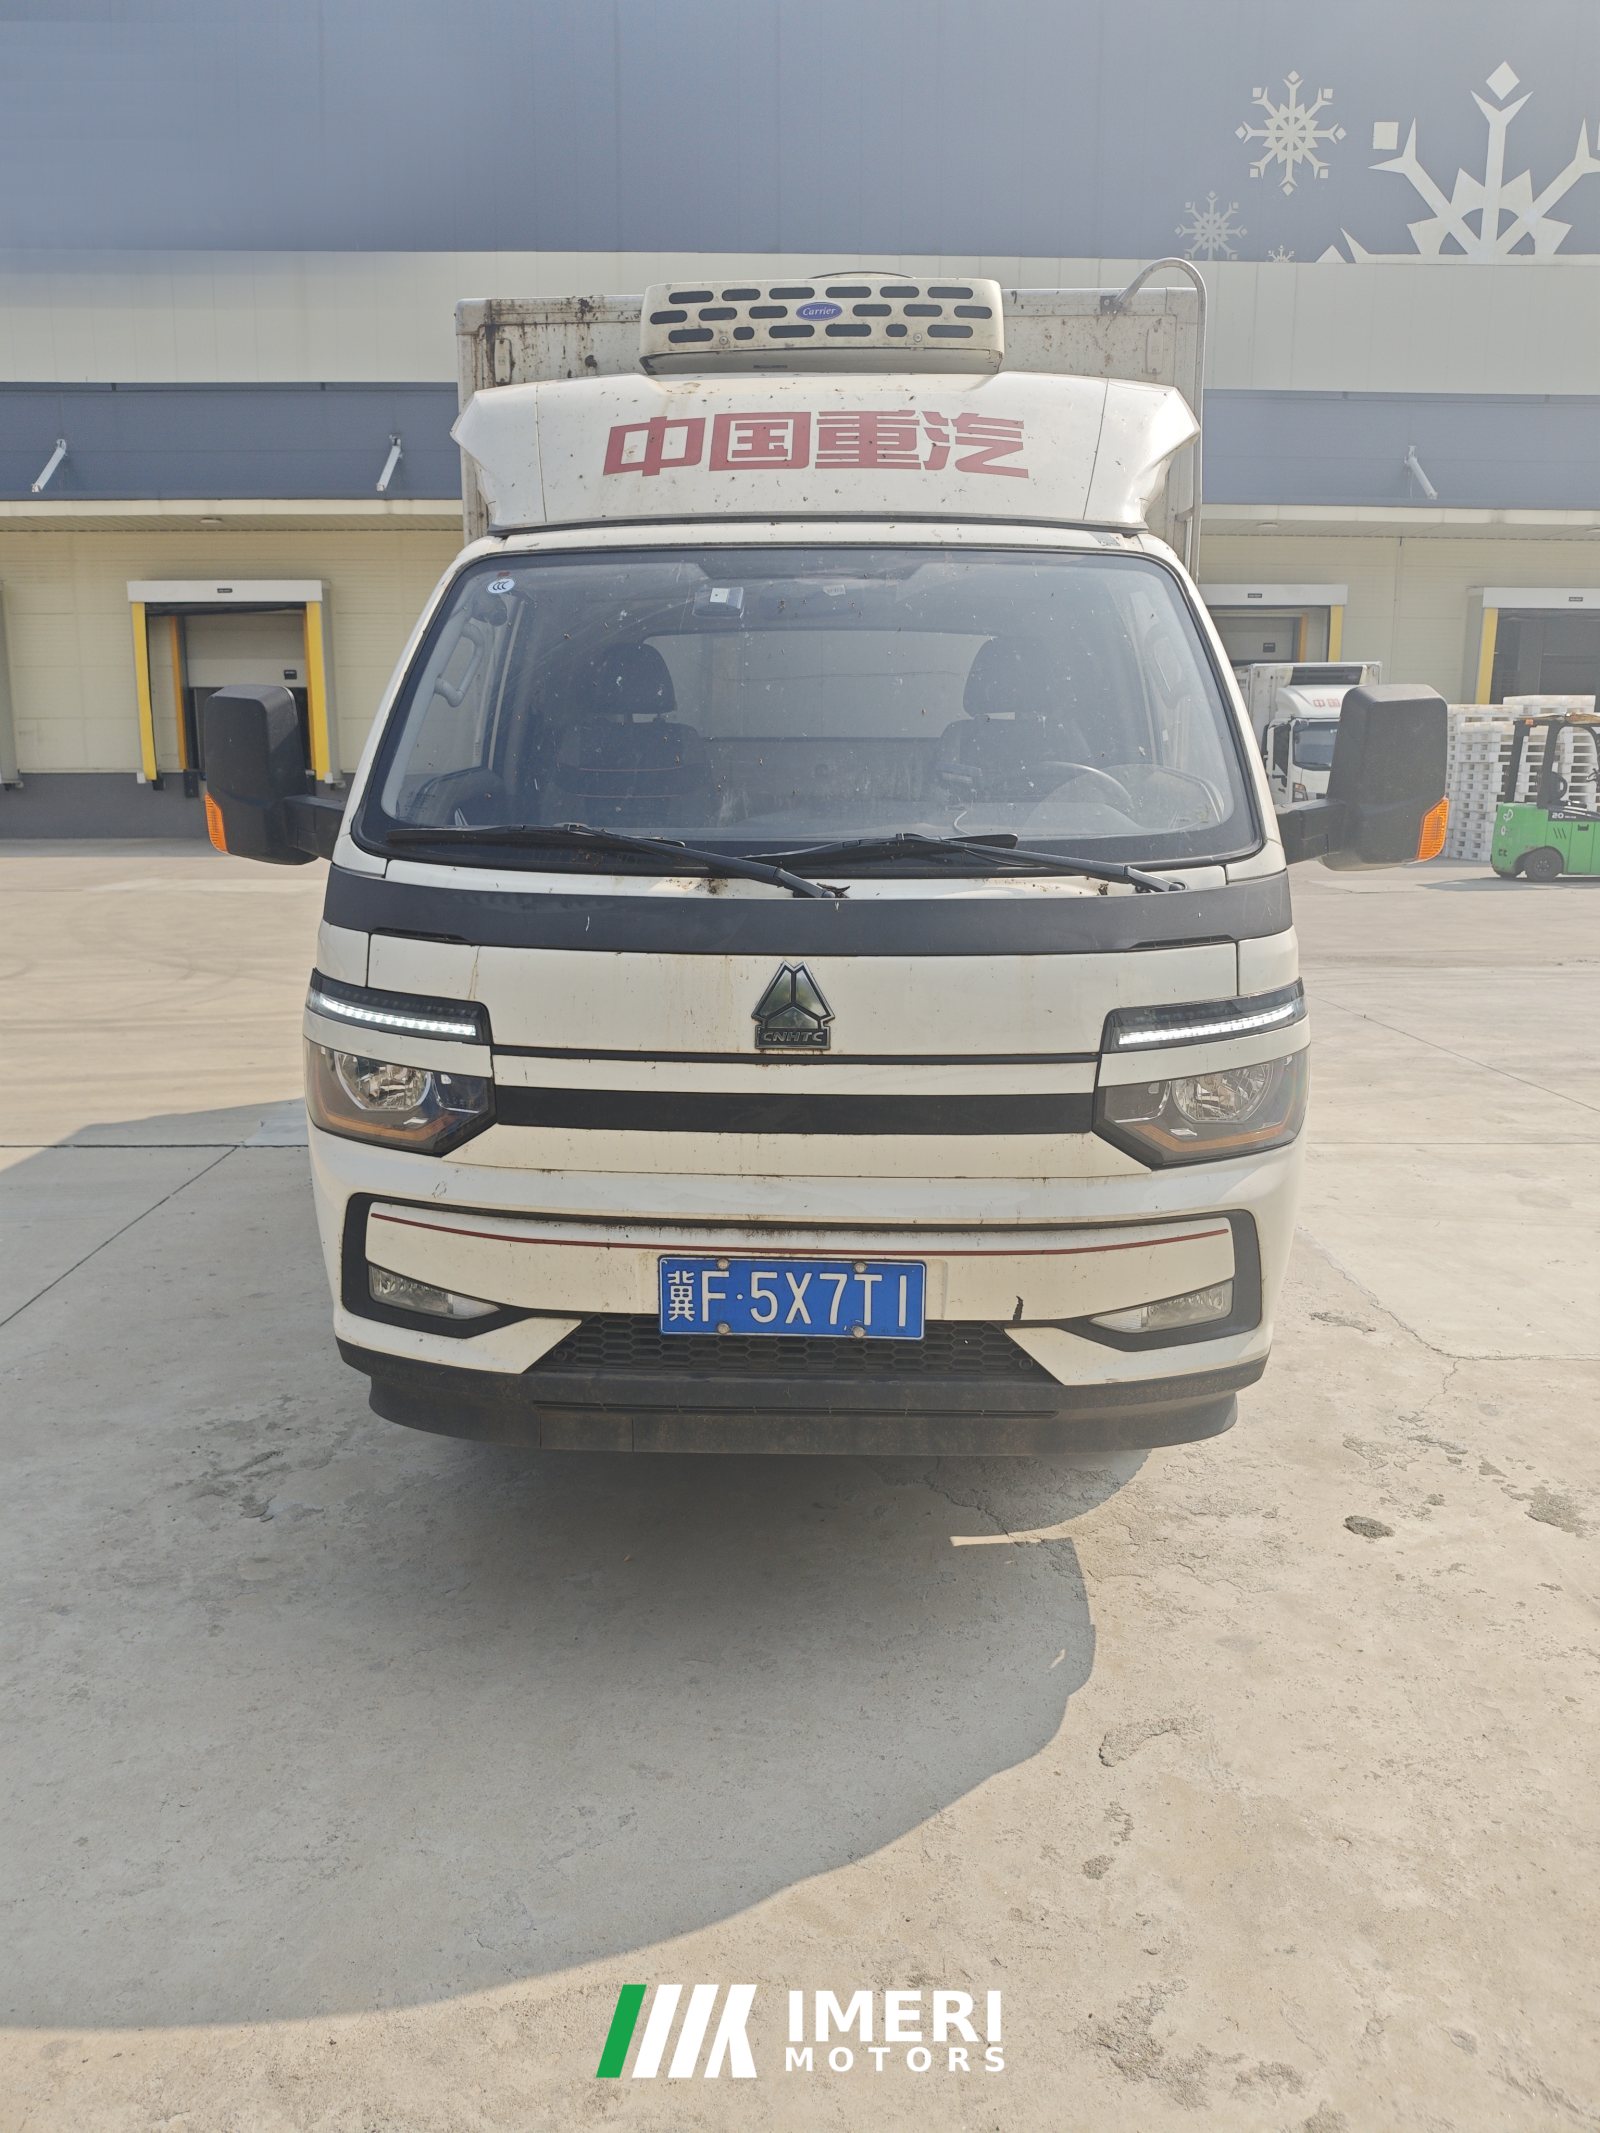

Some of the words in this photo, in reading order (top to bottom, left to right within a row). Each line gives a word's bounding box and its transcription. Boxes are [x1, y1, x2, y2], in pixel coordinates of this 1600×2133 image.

[802, 307, 836, 316] Carrier
[602, 410, 1029, 478] 中国重汽
[763, 1031, 824, 1042] CNHTC
